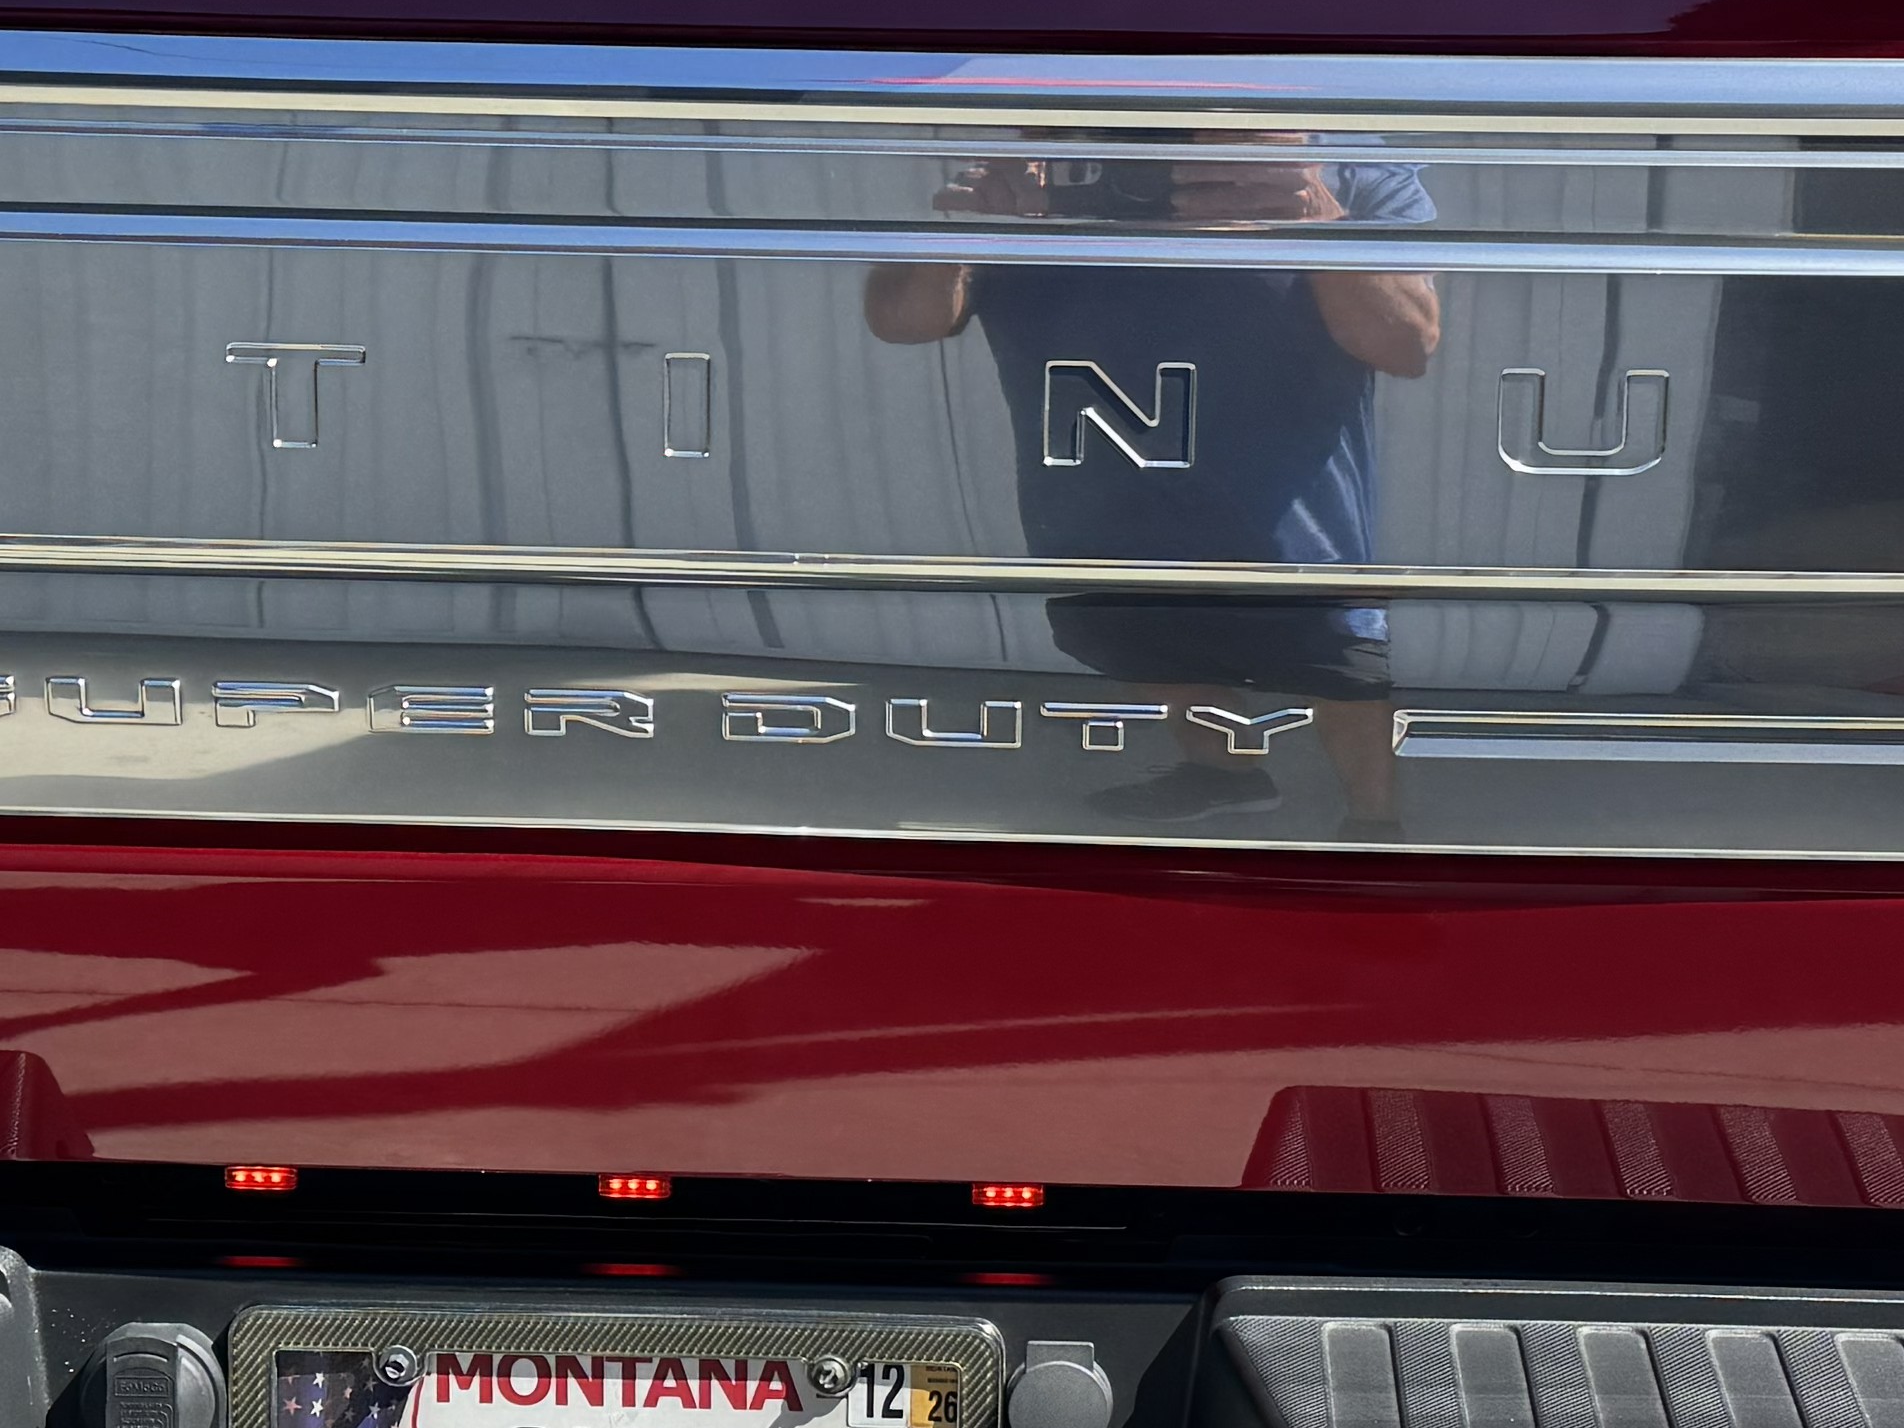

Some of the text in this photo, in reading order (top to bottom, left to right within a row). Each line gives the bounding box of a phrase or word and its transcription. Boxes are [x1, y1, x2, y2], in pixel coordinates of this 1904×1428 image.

[721, 691, 1314, 755] DUTY
[435, 1352, 804, 1412] MONTANA
[859, 1363, 905, 1419] 12
[927, 1390, 959, 1423] 26
